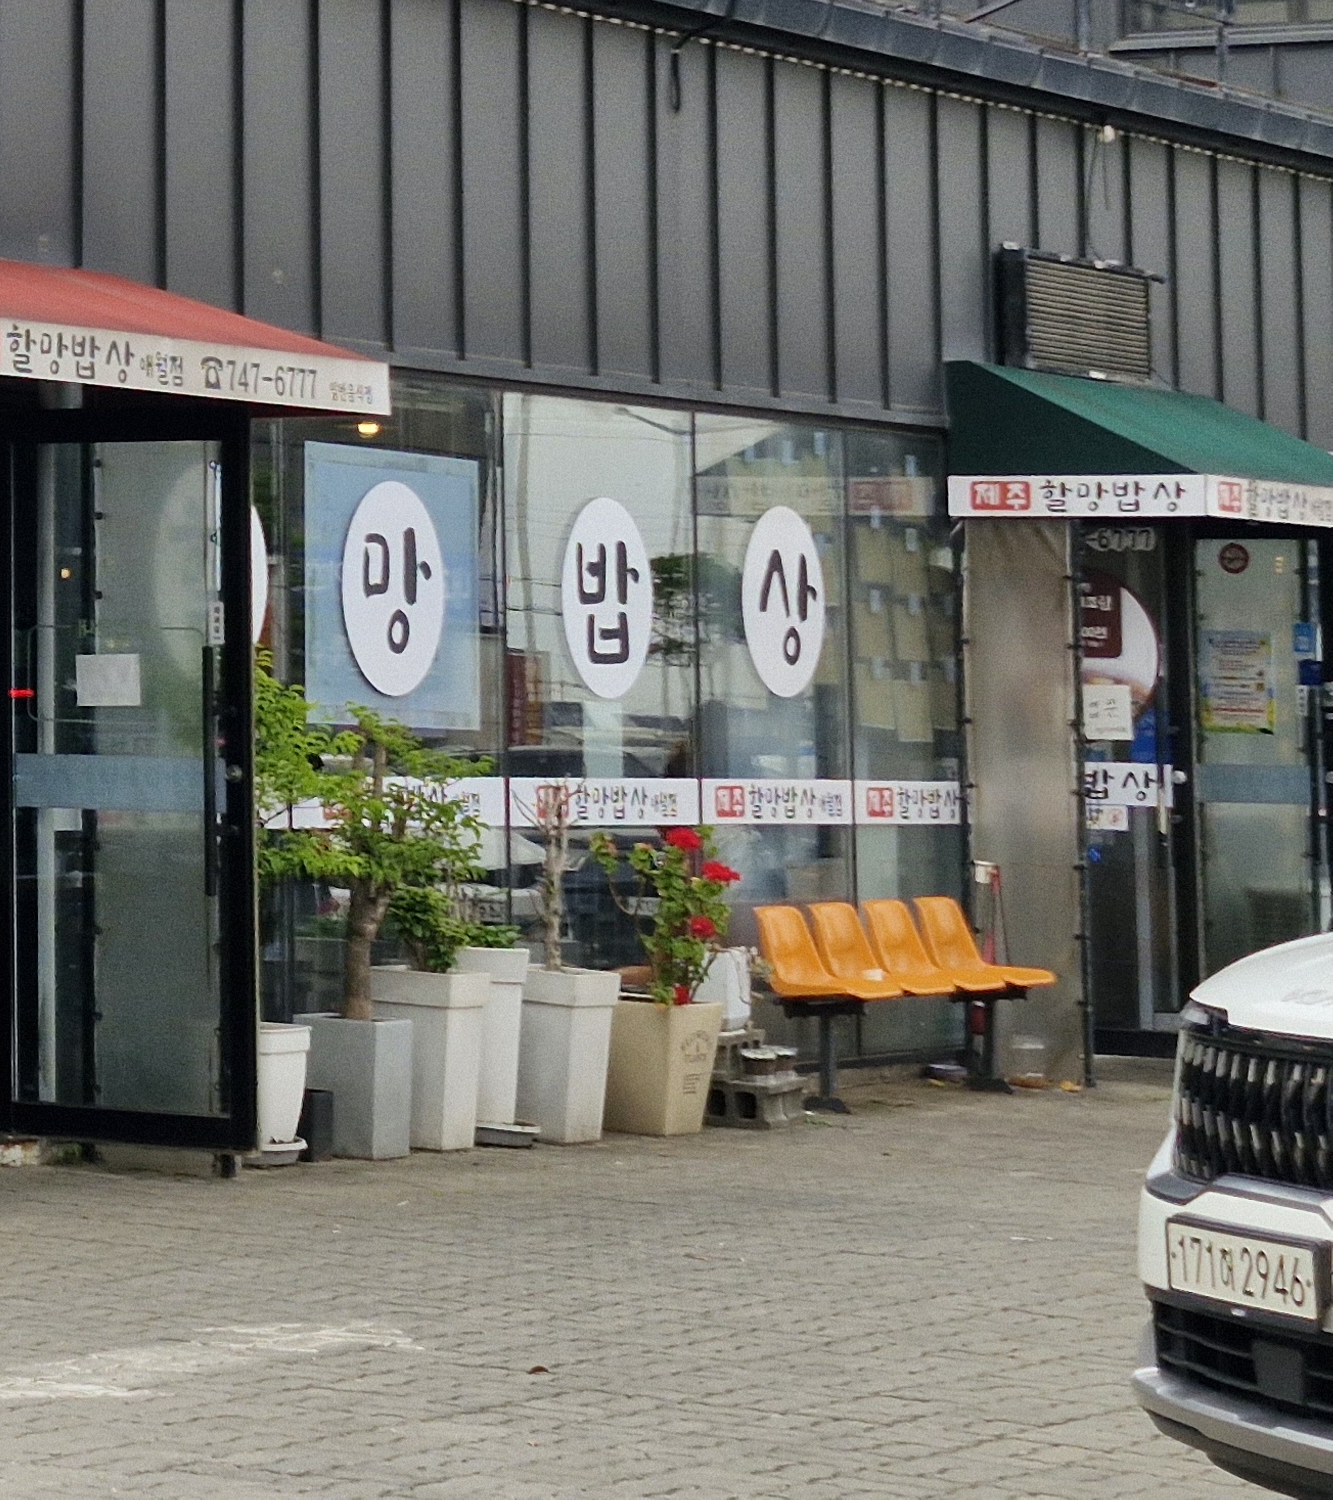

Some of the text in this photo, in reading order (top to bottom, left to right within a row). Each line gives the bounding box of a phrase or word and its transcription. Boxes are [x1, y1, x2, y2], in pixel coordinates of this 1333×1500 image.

[6, 323, 135, 383] 할망밥상
[139, 351, 184, 387] 애월점
[226, 360, 318, 399] 747-6777
[972, 479, 1186, 514] 제주 할망밥상
[363, 526, 818, 666] 망 밥 상
[748, 783, 816, 820] 할망밥상
